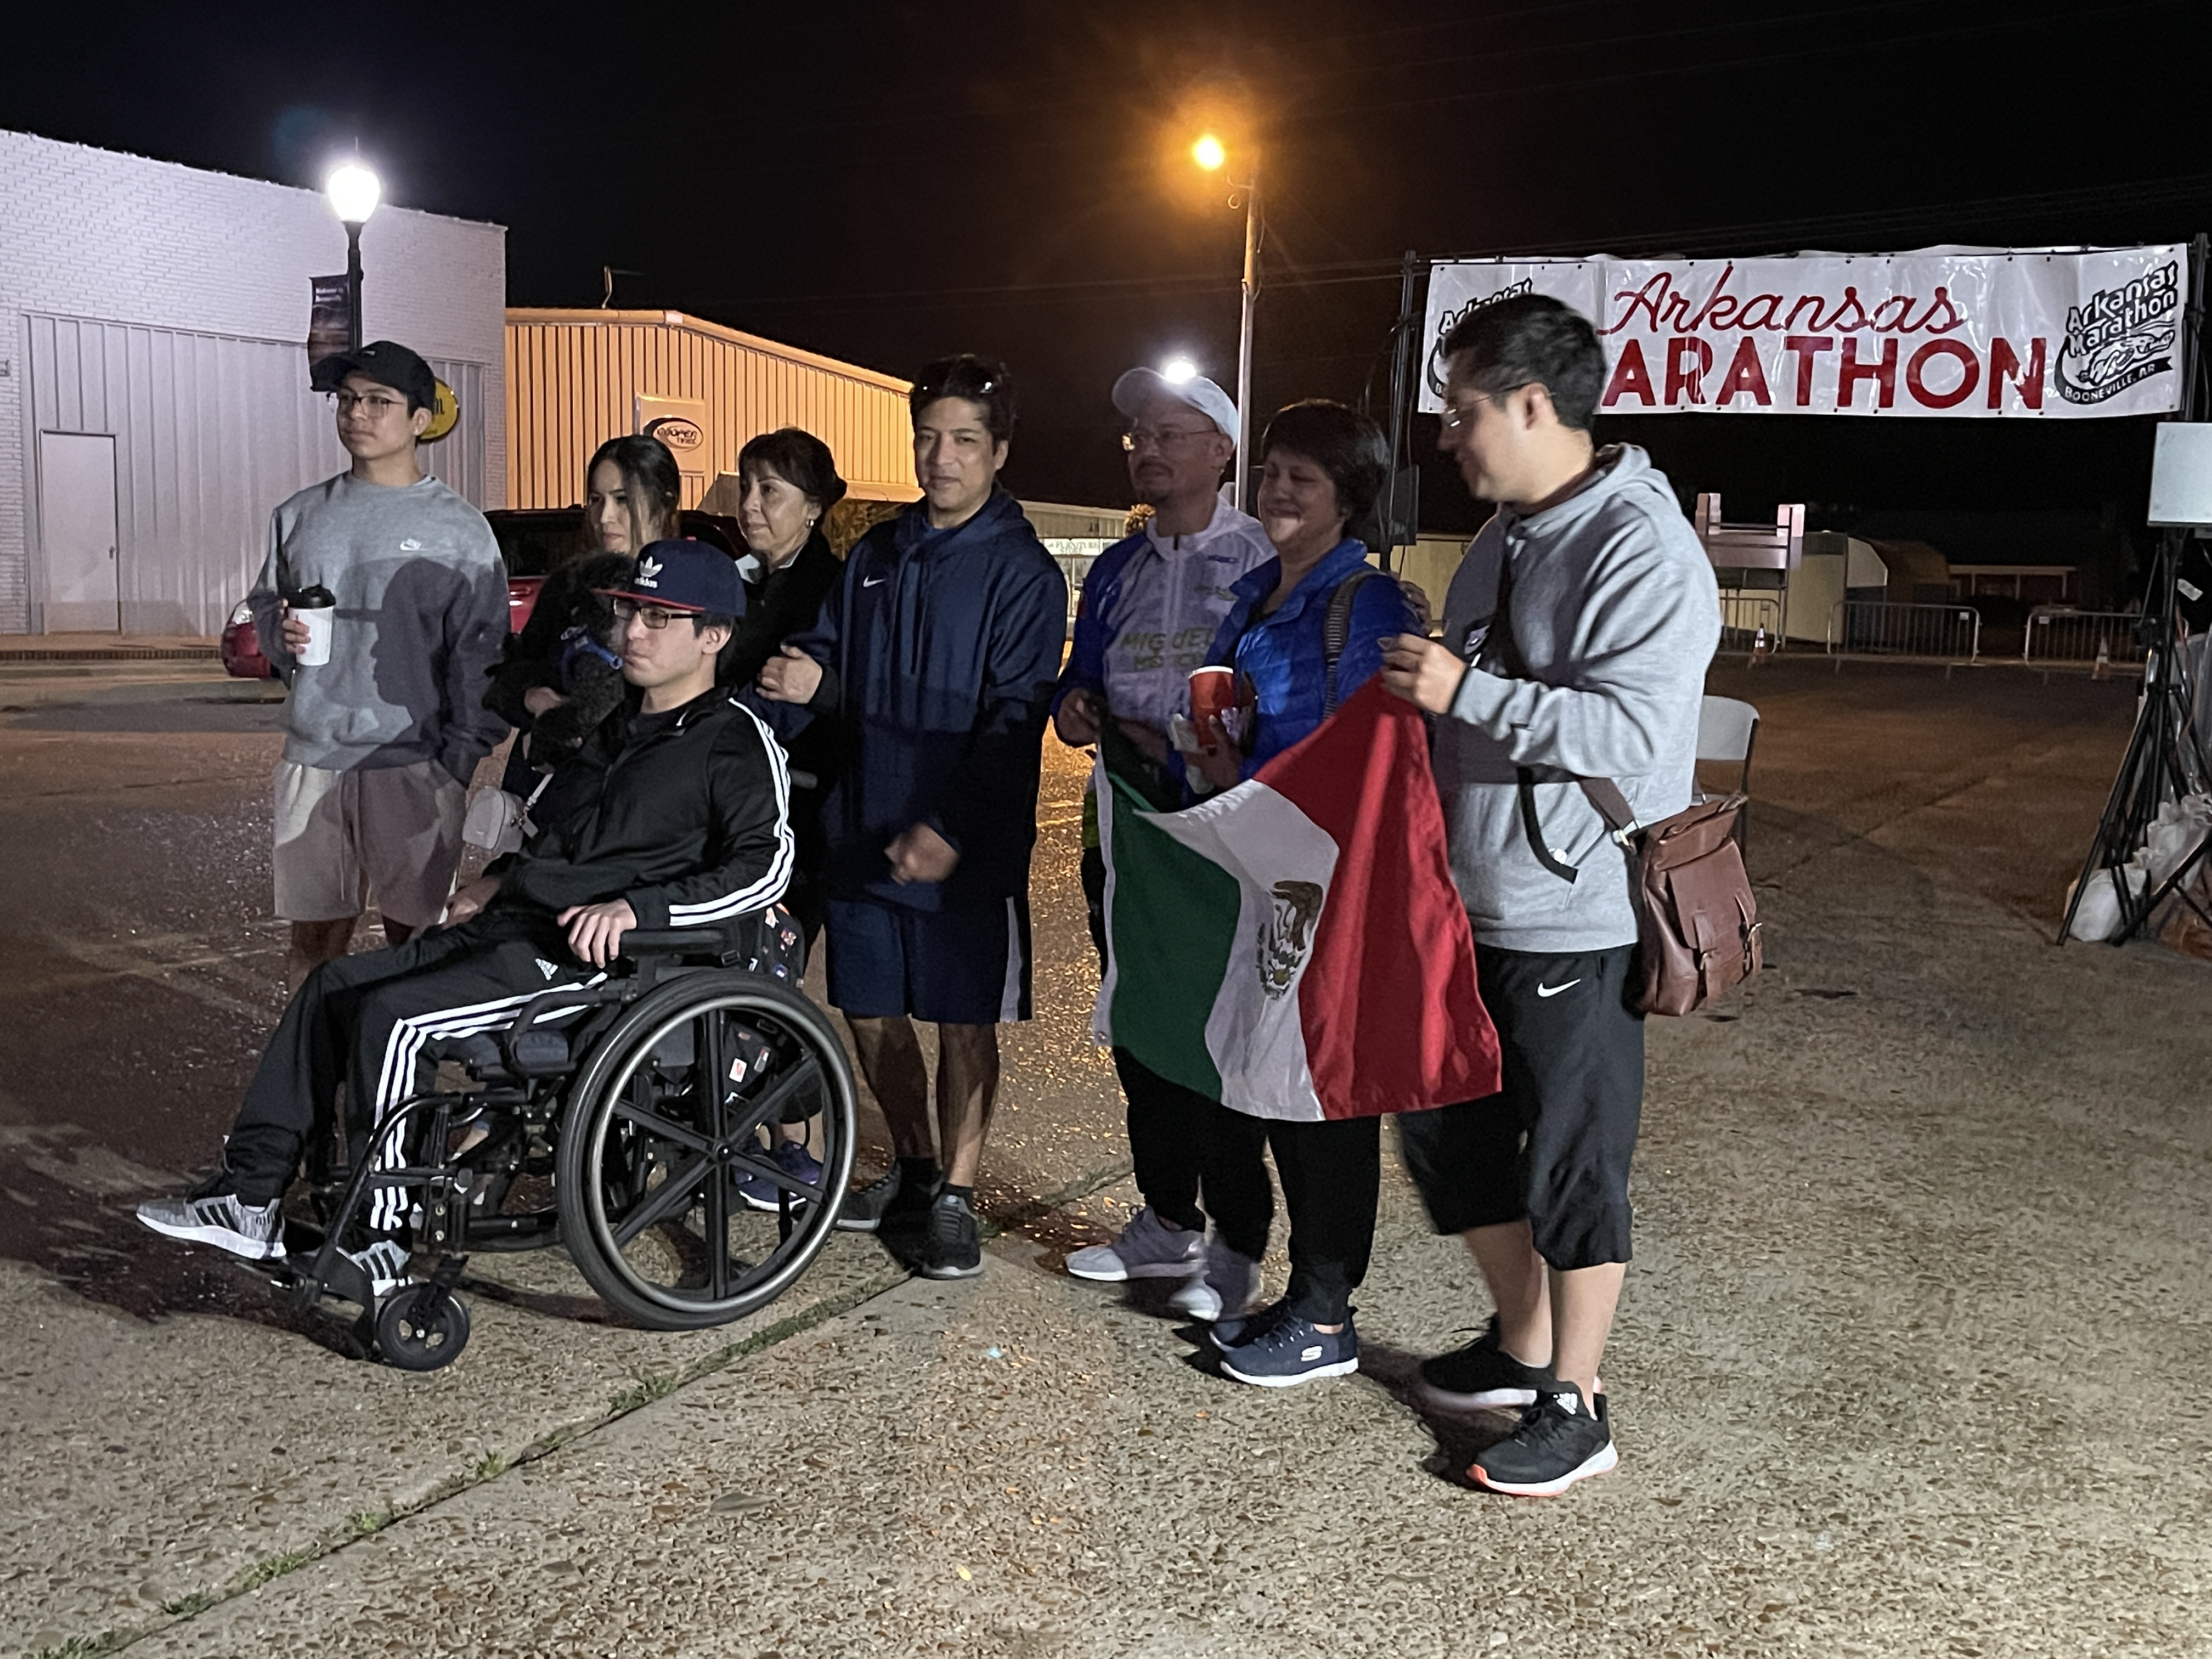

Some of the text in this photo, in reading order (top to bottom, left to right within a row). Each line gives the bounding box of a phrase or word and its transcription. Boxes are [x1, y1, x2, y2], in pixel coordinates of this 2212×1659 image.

[1597, 265, 1969, 336] Arkansas
[2066, 260, 2179, 334] Arkansas
[2068, 287, 2178, 358] Marathon
[1601, 336, 2046, 409] ARATHON
[2140, 363, 2155, 377] AR
